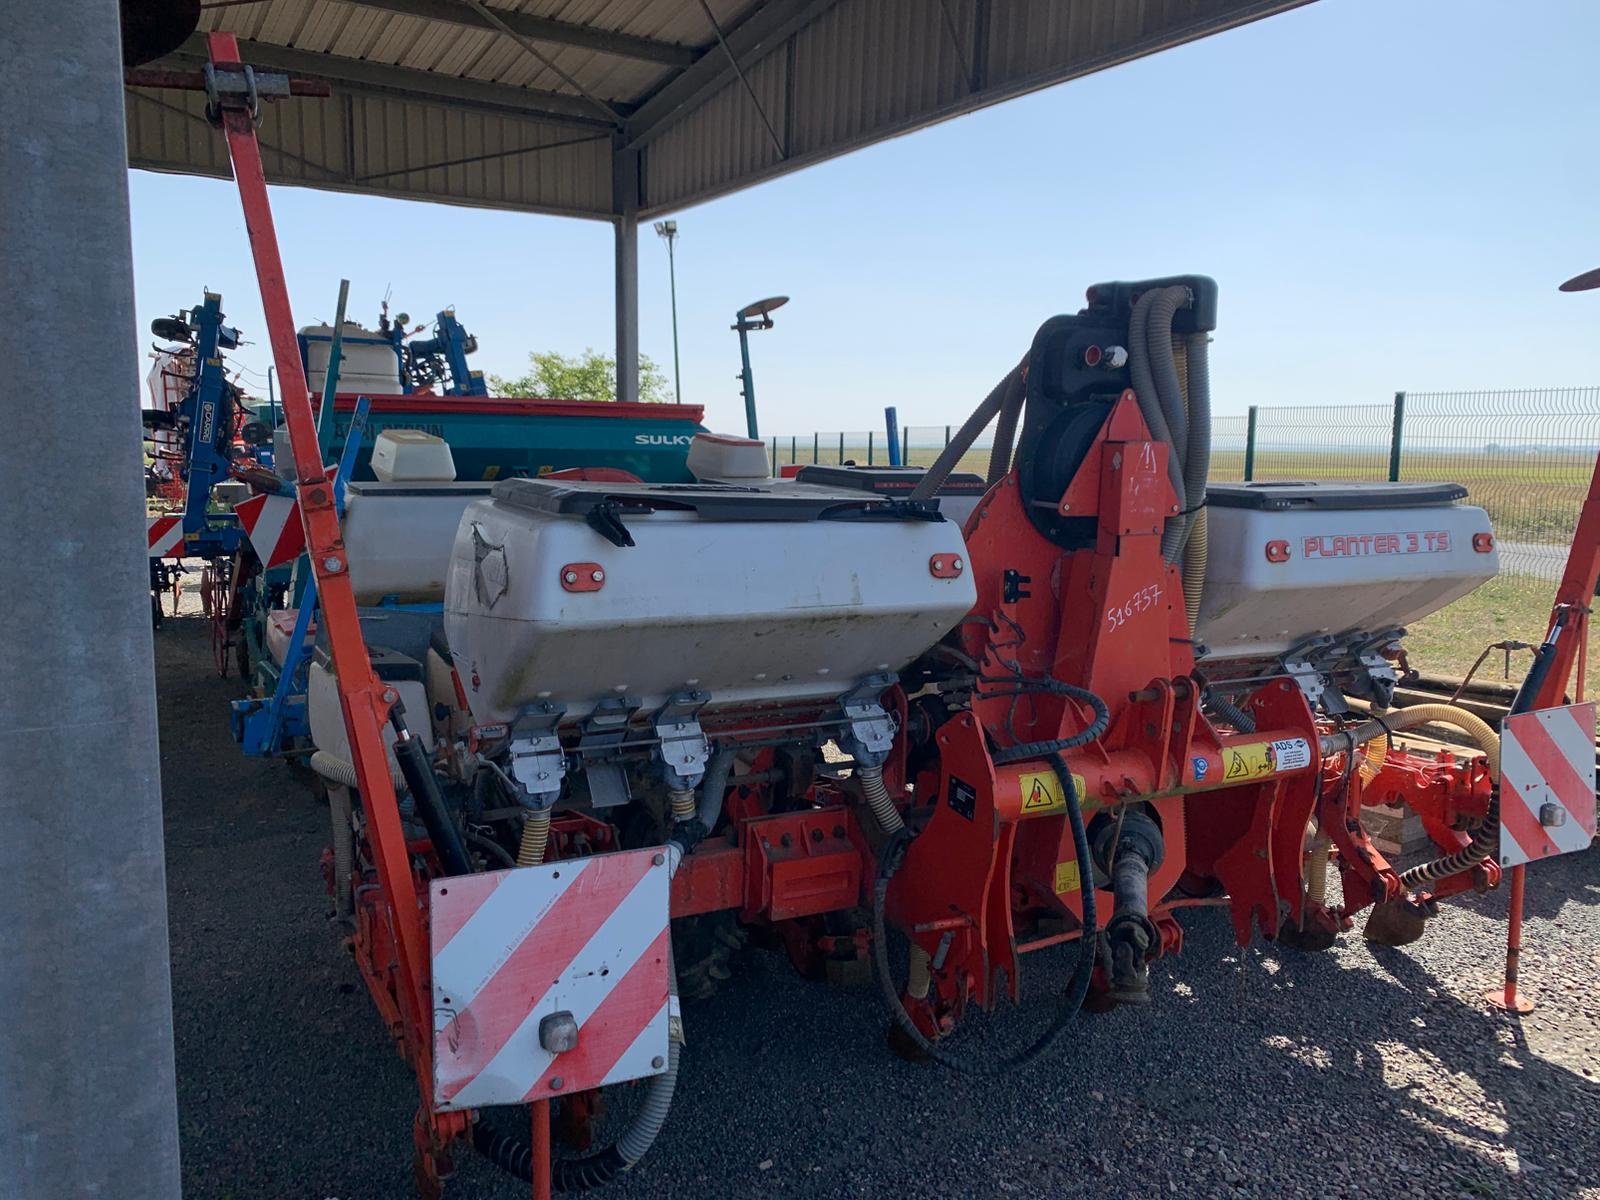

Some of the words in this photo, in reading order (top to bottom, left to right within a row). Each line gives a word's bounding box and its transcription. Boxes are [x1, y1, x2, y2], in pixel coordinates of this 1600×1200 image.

[634, 434, 696, 445] SULKY
[1303, 533, 1401, 558] PLANTER
[1406, 533, 1420, 553] 3
[1423, 531, 1449, 552] TS
[1107, 583, 1164, 633] 516737
[1274, 741, 1294, 751] ADS
